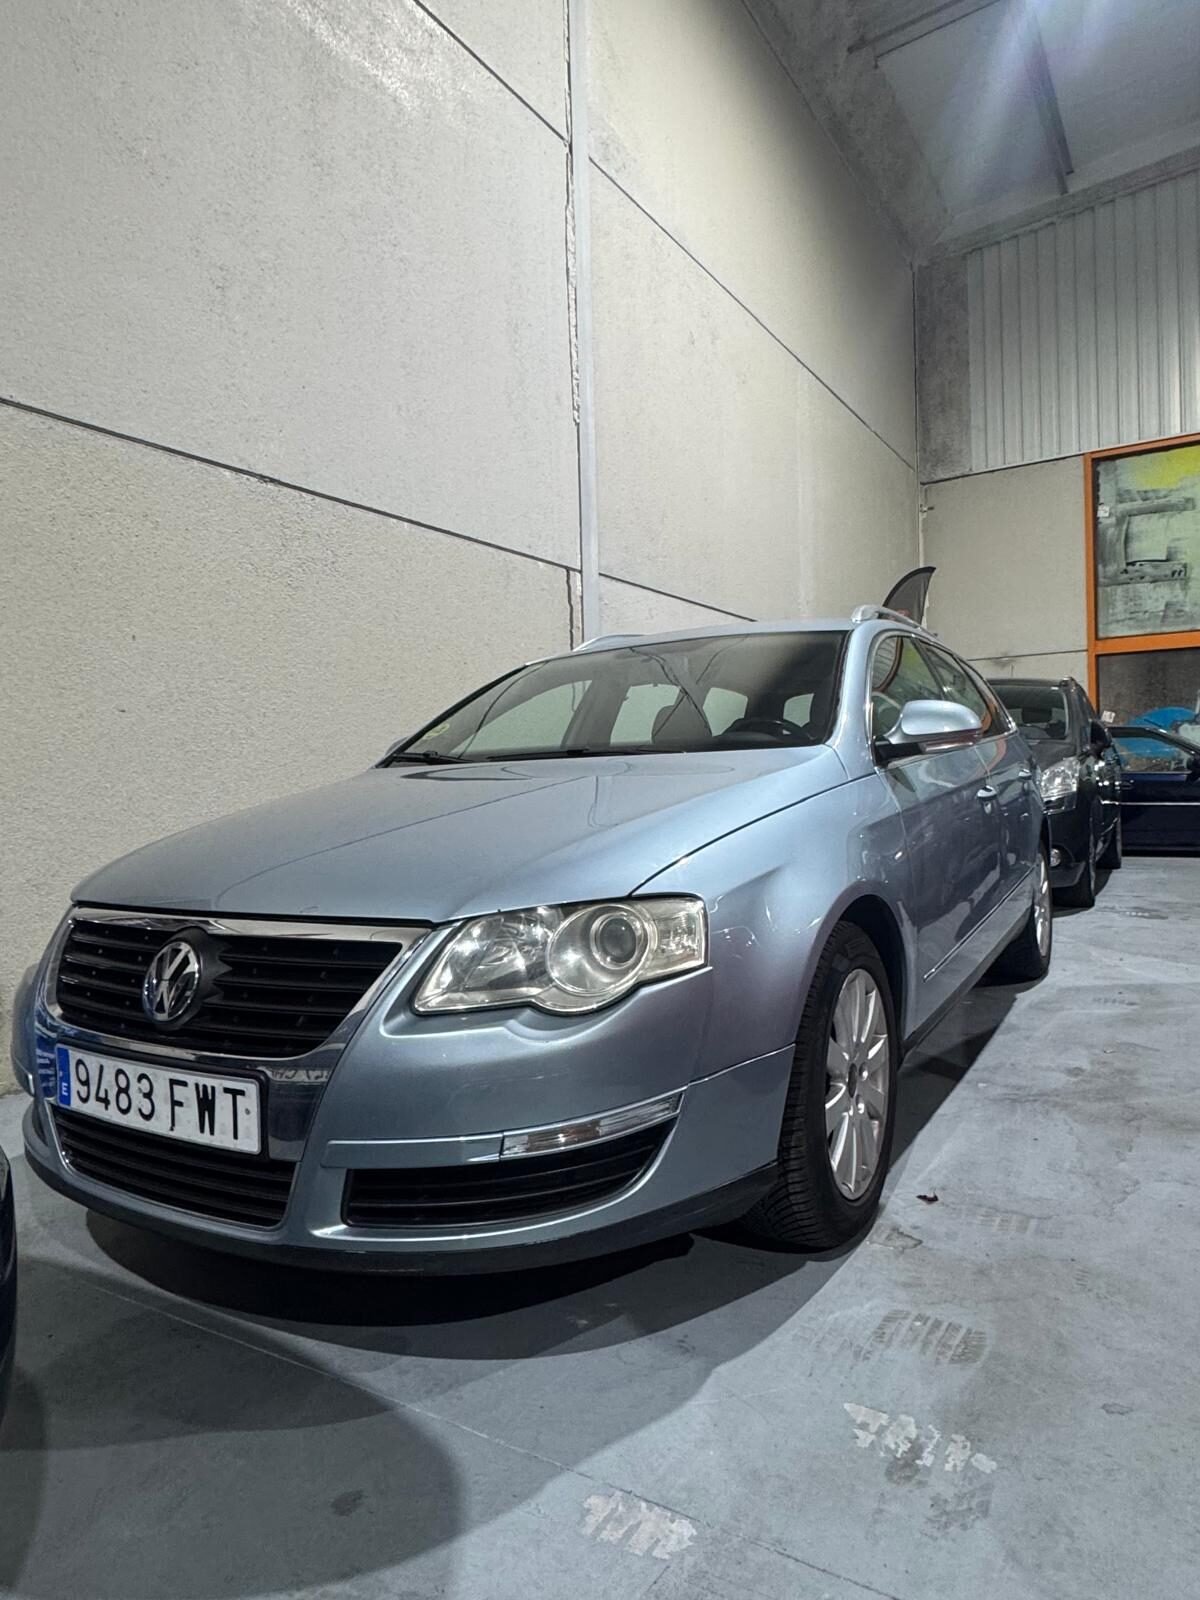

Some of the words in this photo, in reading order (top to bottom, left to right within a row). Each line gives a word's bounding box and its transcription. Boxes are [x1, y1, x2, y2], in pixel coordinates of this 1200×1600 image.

[61, 1082, 69, 1096] E
[75, 1058, 156, 1121] 9483
[169, 1078, 246, 1140] FWT
